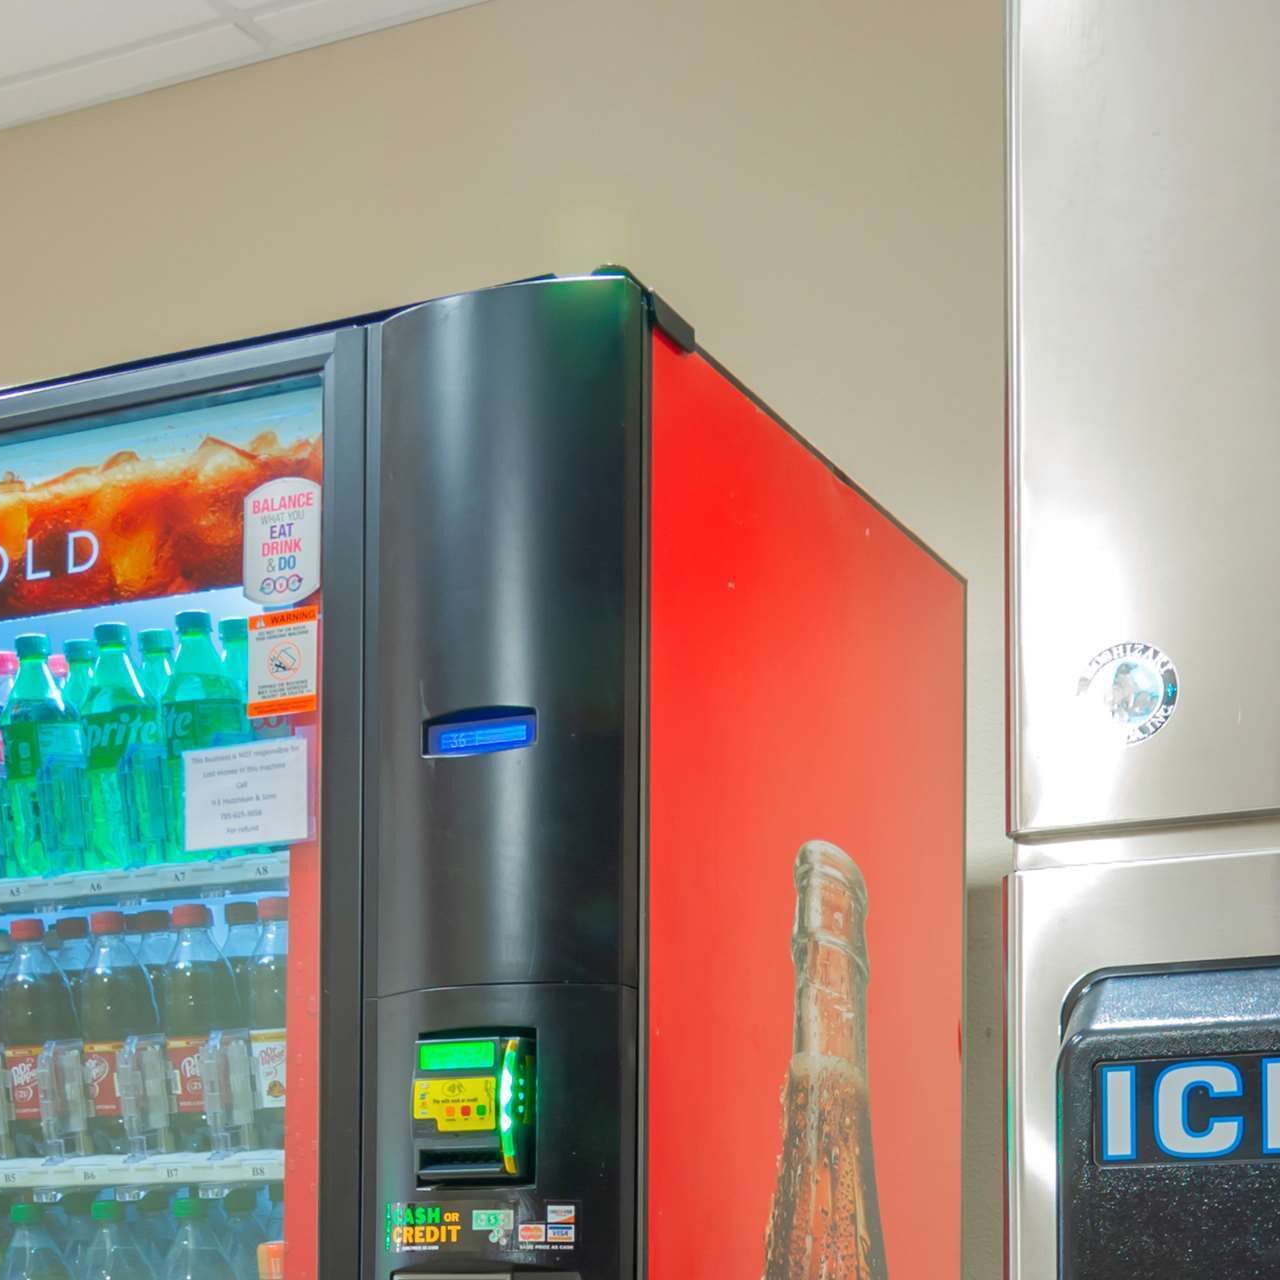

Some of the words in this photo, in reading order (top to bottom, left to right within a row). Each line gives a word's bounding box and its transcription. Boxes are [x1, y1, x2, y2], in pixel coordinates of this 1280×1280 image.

[252, 491, 313, 514] BALANCE
[261, 512, 285, 525] WHAT
[288, 509, 304, 521] YOU
[269, 522, 294, 539] EAT
[261, 538, 302, 557] DRINK
[266, 558, 276, 572] &
[278, 555, 296, 571] DO
[270, 608, 317, 625] WARNING
[173, 872, 186, 883] A7
[255, 865, 268, 878] A8
[8, 887, 21, 897] A5
[89, 882, 102, 893] A6
[83, 1170, 96, 1181] B6
[166, 1168, 179, 1179] B7
[251, 1166, 265, 1177] B8
[4, 1174, 16, 1184] B5
[394, 1207, 441, 1225] CASH
[443, 1212, 460, 1222] OR
[392, 1225, 462, 1244] CREDIT
